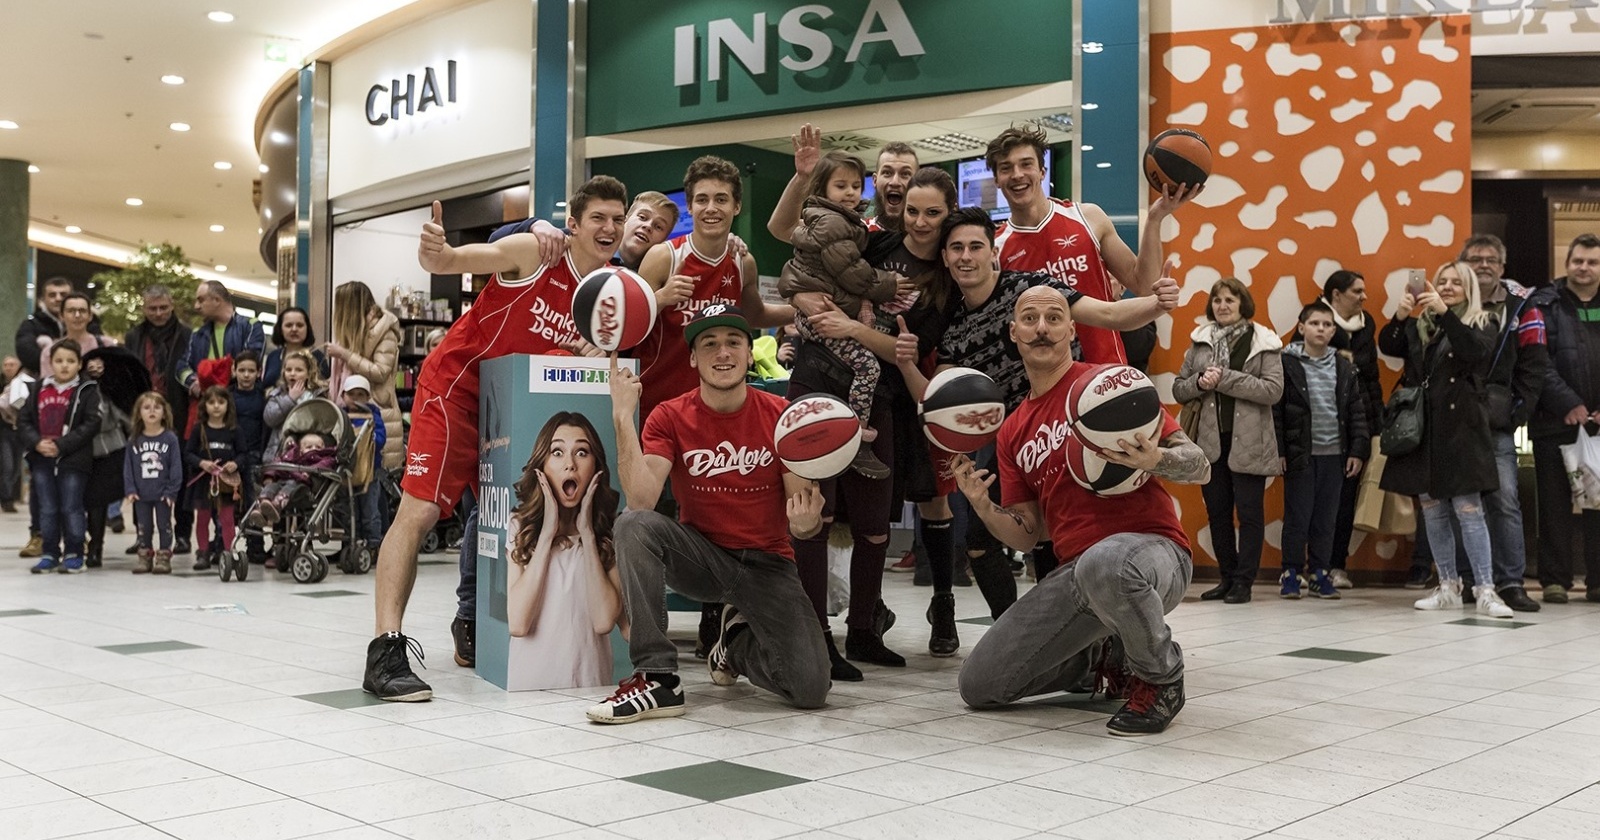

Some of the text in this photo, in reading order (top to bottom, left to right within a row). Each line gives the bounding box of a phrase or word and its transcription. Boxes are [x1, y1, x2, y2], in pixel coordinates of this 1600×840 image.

[674, 0, 926, 87] INSA
[365, 59, 457, 126] CHAI
[883, 262, 908, 272] LIVE
[1036, 255, 1089, 276] nking
[529, 296, 579, 335] Dunk
[543, 368, 611, 384] EUROPAR
[682, 440, 774, 478] DaMove
